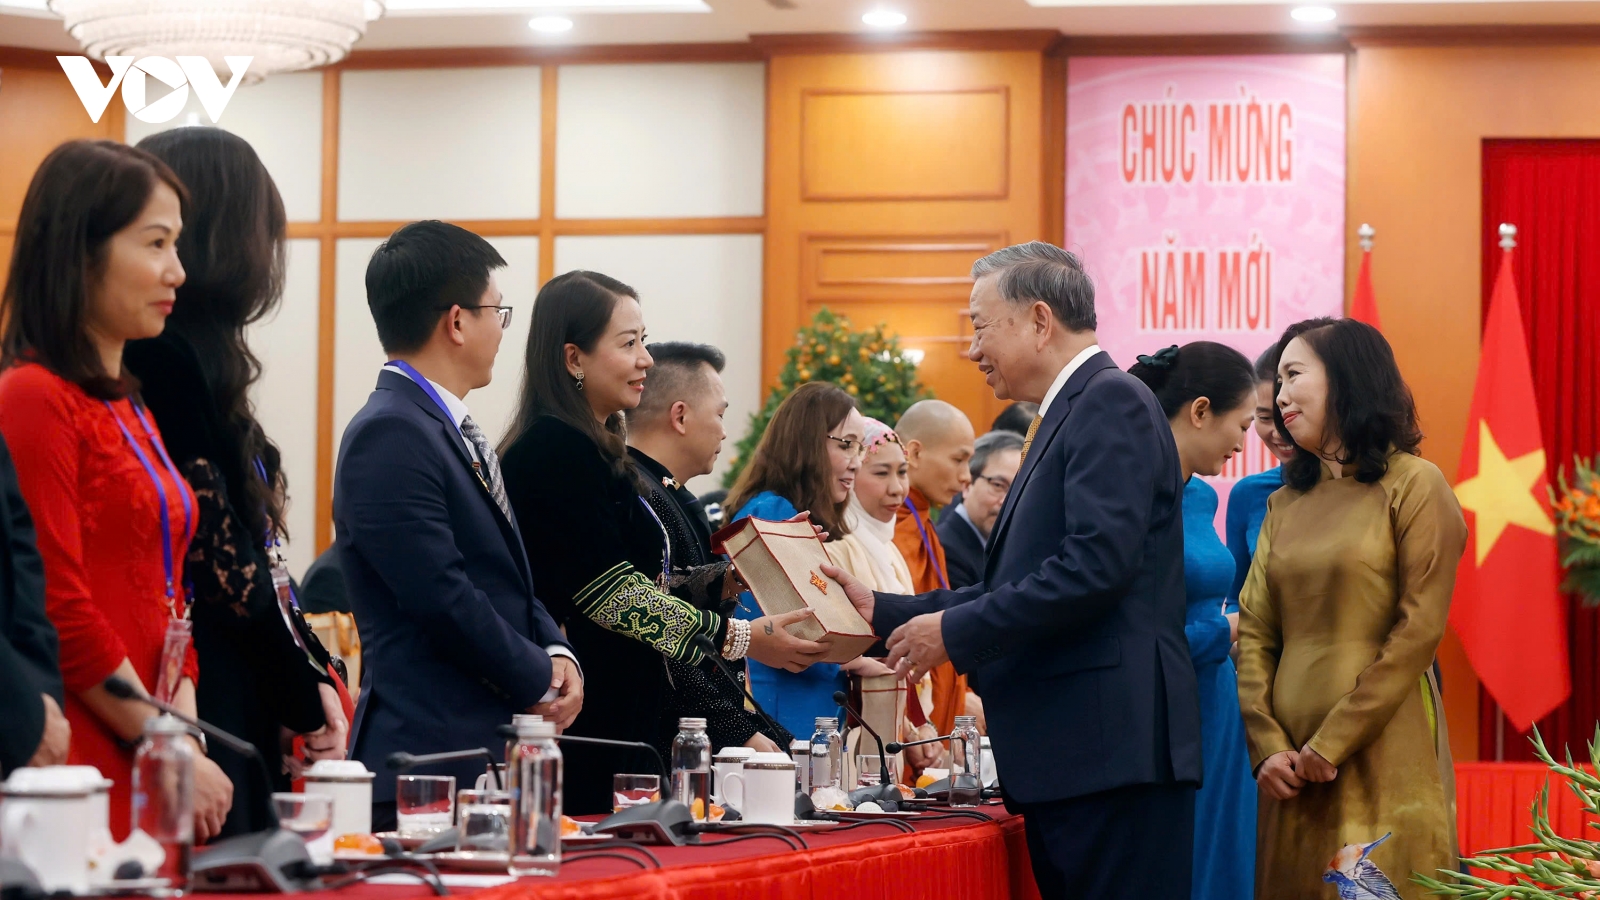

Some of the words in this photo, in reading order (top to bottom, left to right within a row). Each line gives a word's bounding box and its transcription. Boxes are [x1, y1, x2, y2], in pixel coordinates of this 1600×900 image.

[1122, 86, 1196, 183] CHÚC
[1208, 86, 1293, 183] MỪNG
[1141, 232, 1206, 330] NĂM
[1217, 232, 1272, 331] MỚI
